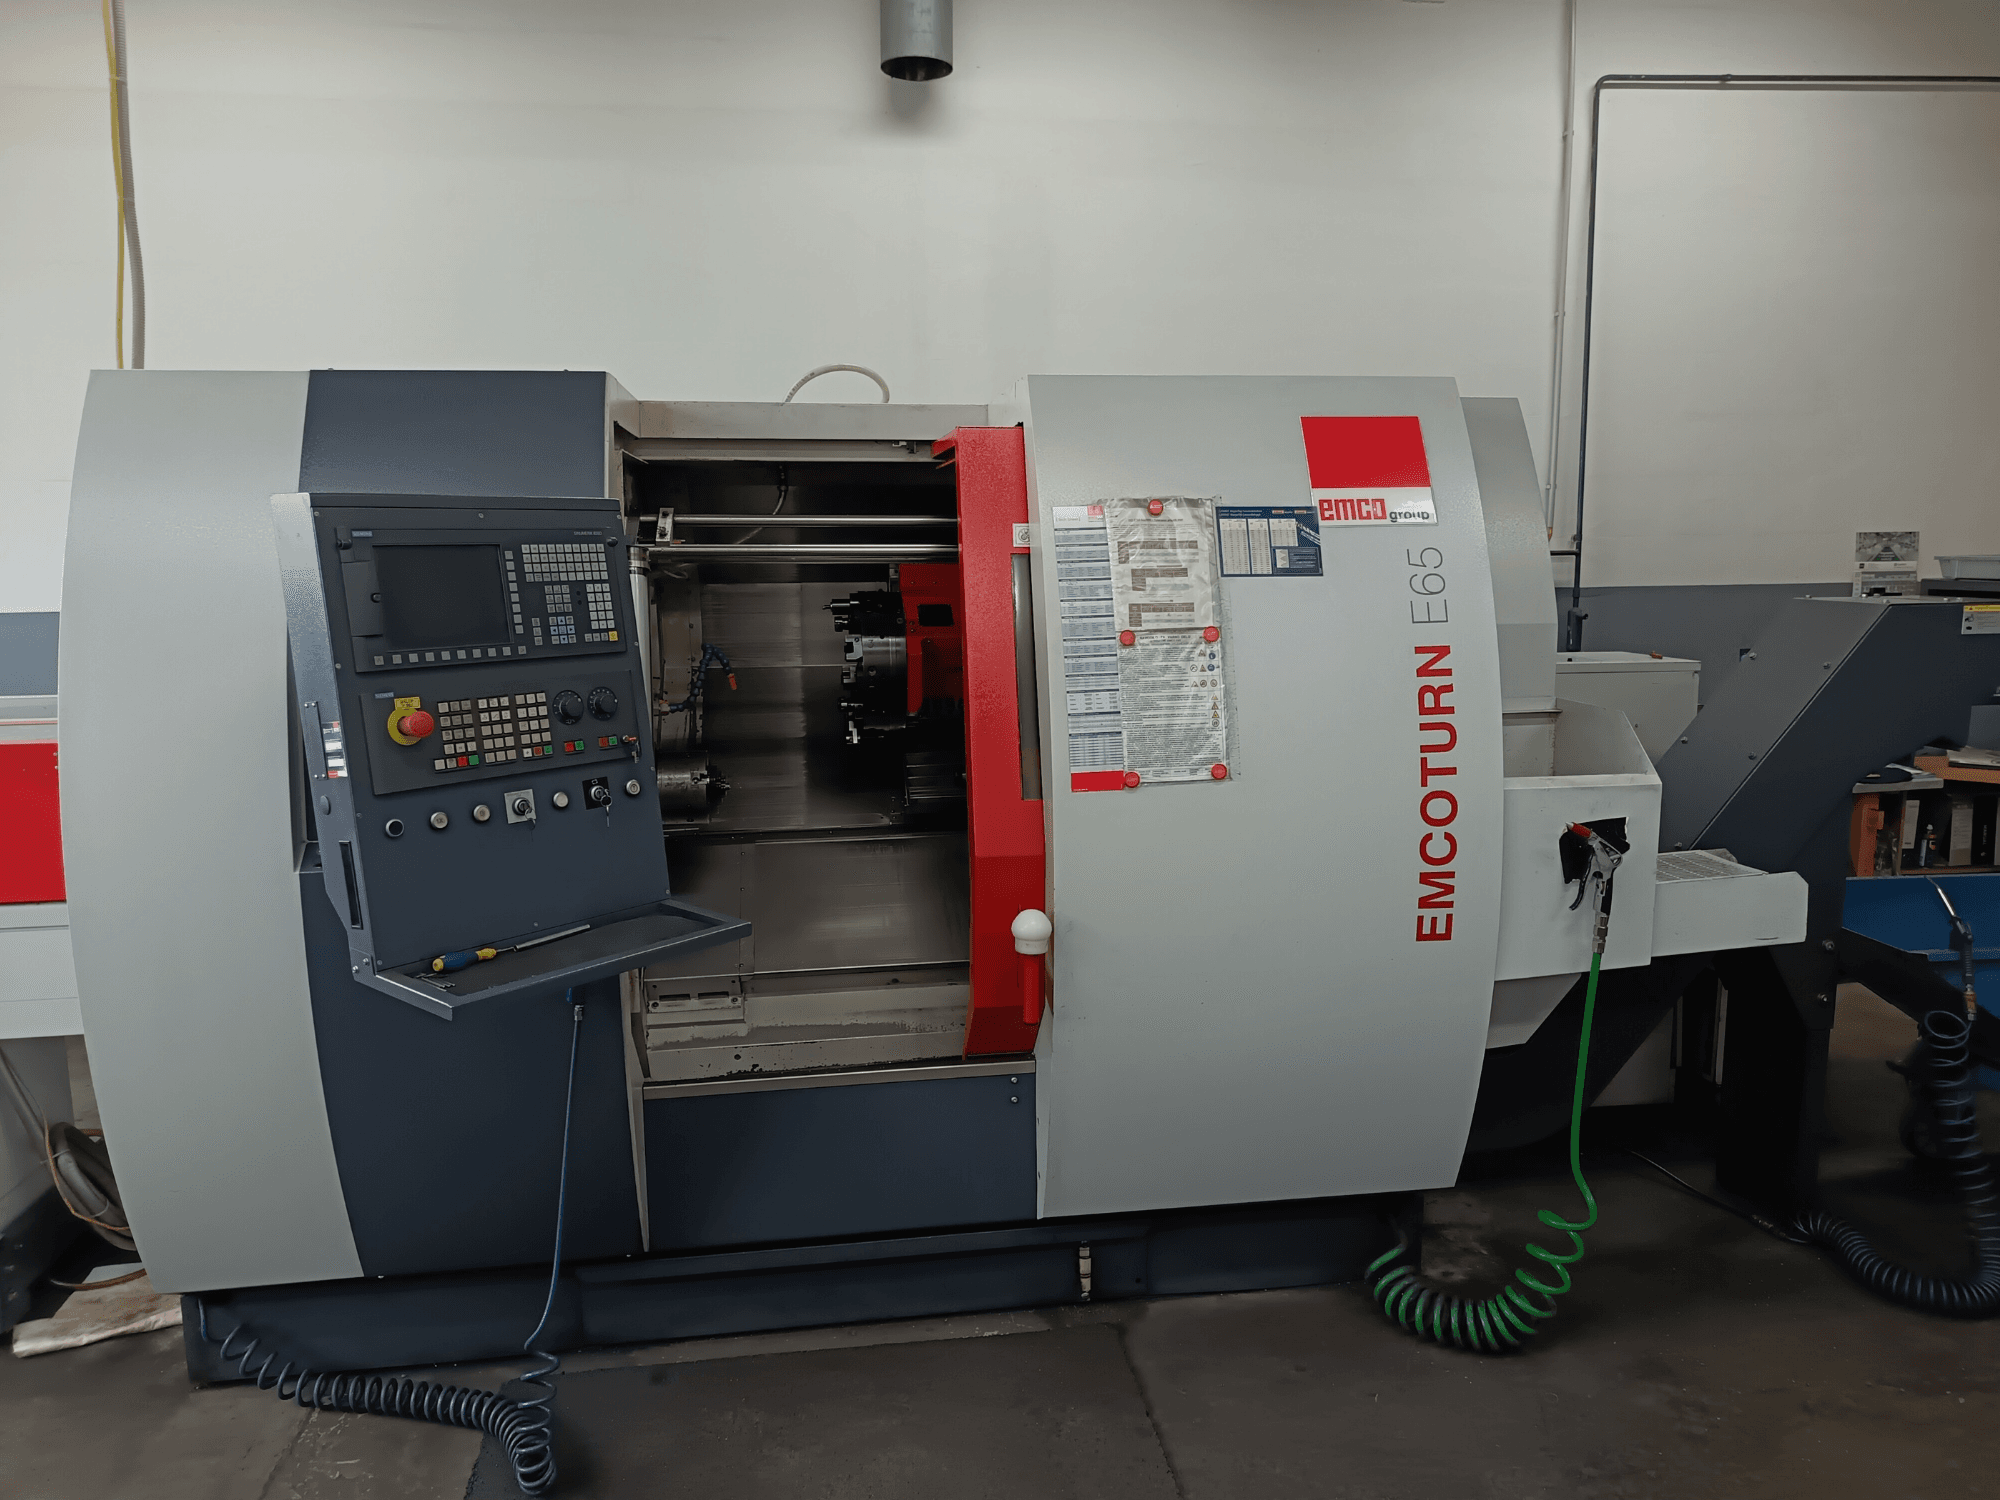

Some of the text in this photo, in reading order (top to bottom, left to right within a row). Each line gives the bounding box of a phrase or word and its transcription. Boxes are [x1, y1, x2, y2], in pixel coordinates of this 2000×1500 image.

[1319, 499, 1387, 521] emco
[1389, 511, 1430, 523] group
[868, 639, 874, 648] 3
[1407, 547, 1459, 942] EMCOTURN E65
